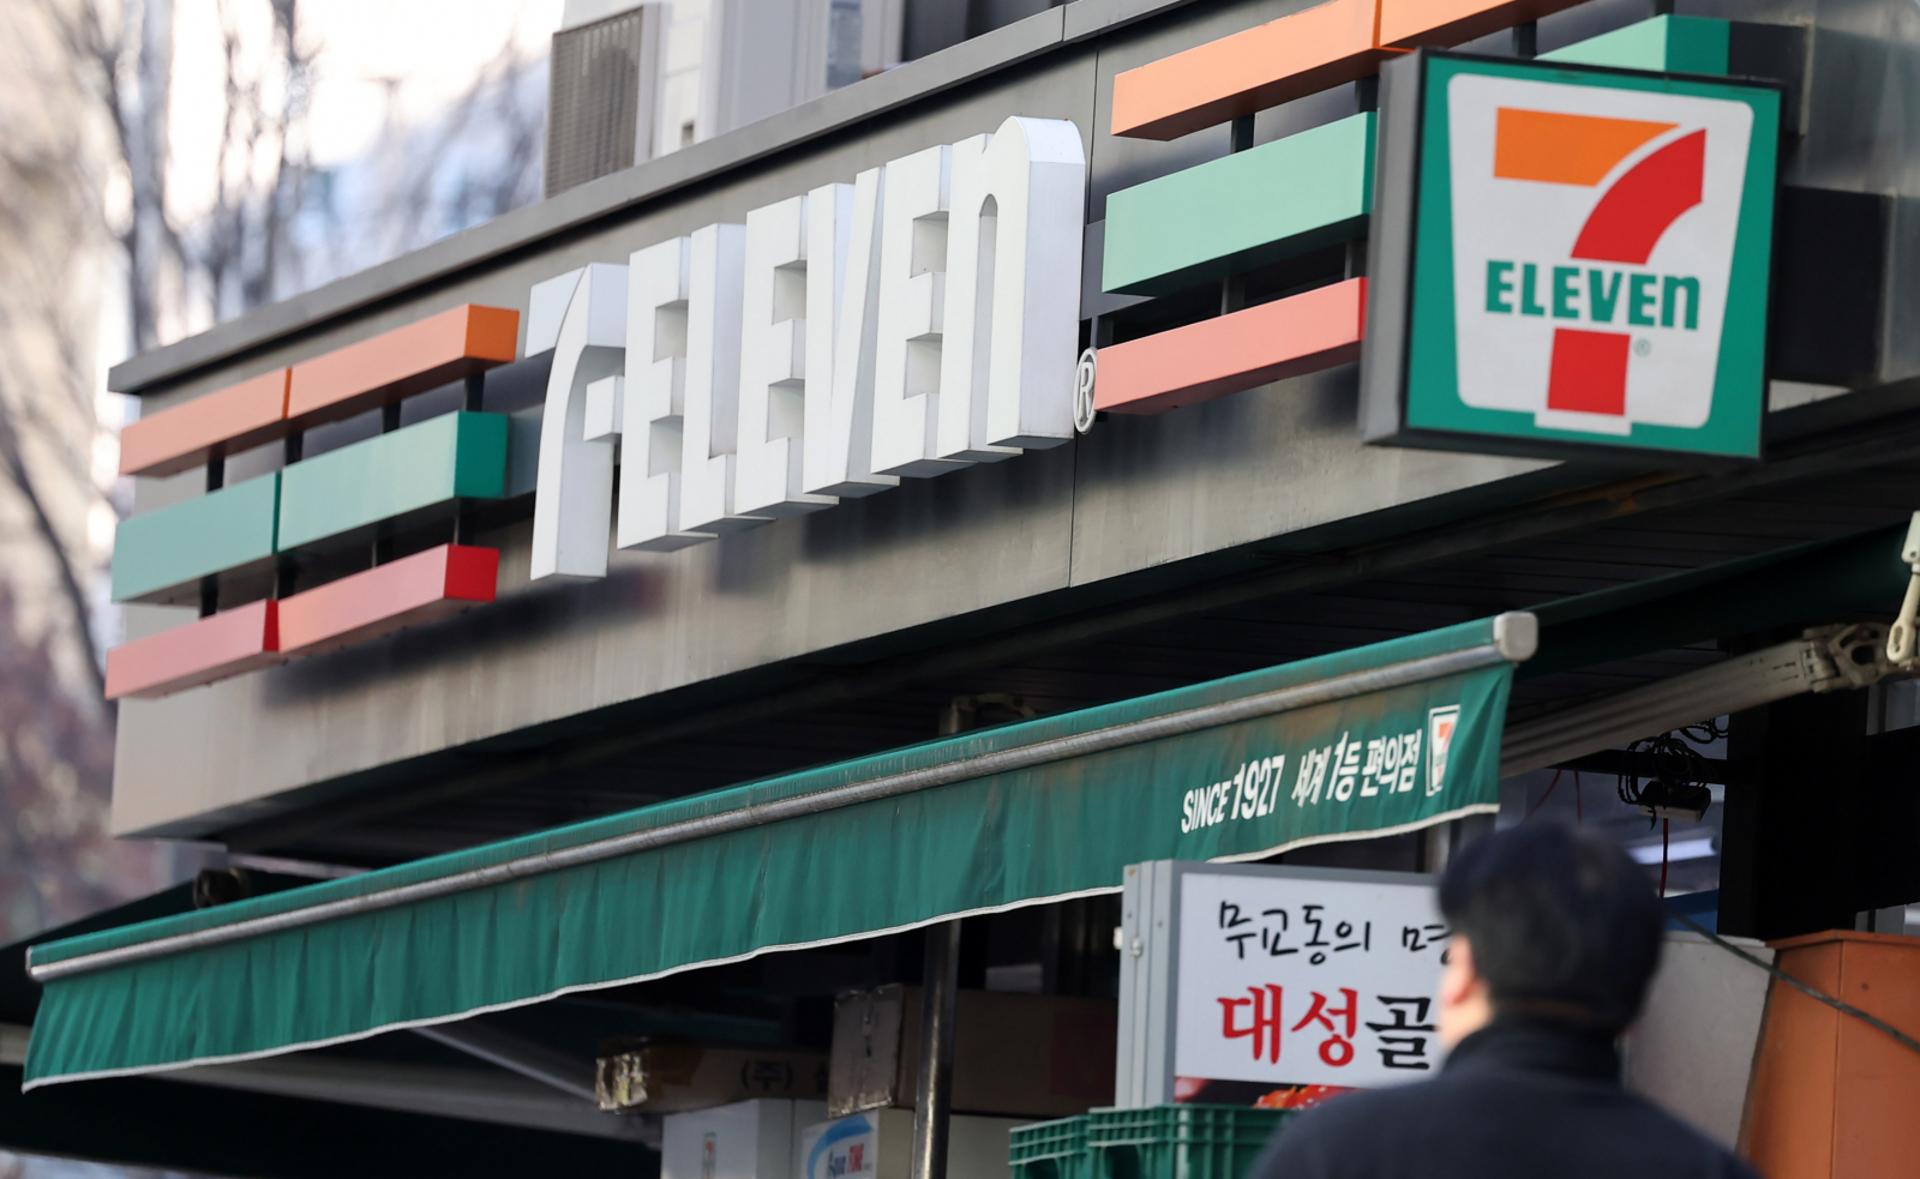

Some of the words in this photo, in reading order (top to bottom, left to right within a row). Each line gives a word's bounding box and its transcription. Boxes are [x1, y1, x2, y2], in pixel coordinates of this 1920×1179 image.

[1493, 106, 1707, 417] 7
[1181, 780, 1231, 834] SINCE
[1230, 755, 1285, 820] 1927
[1291, 745, 1332, 808] 세계
[1325, 731, 1362, 802] 1등
[1360, 728, 1422, 797] 편의점
[1219, 901, 1371, 965] 무교동의
